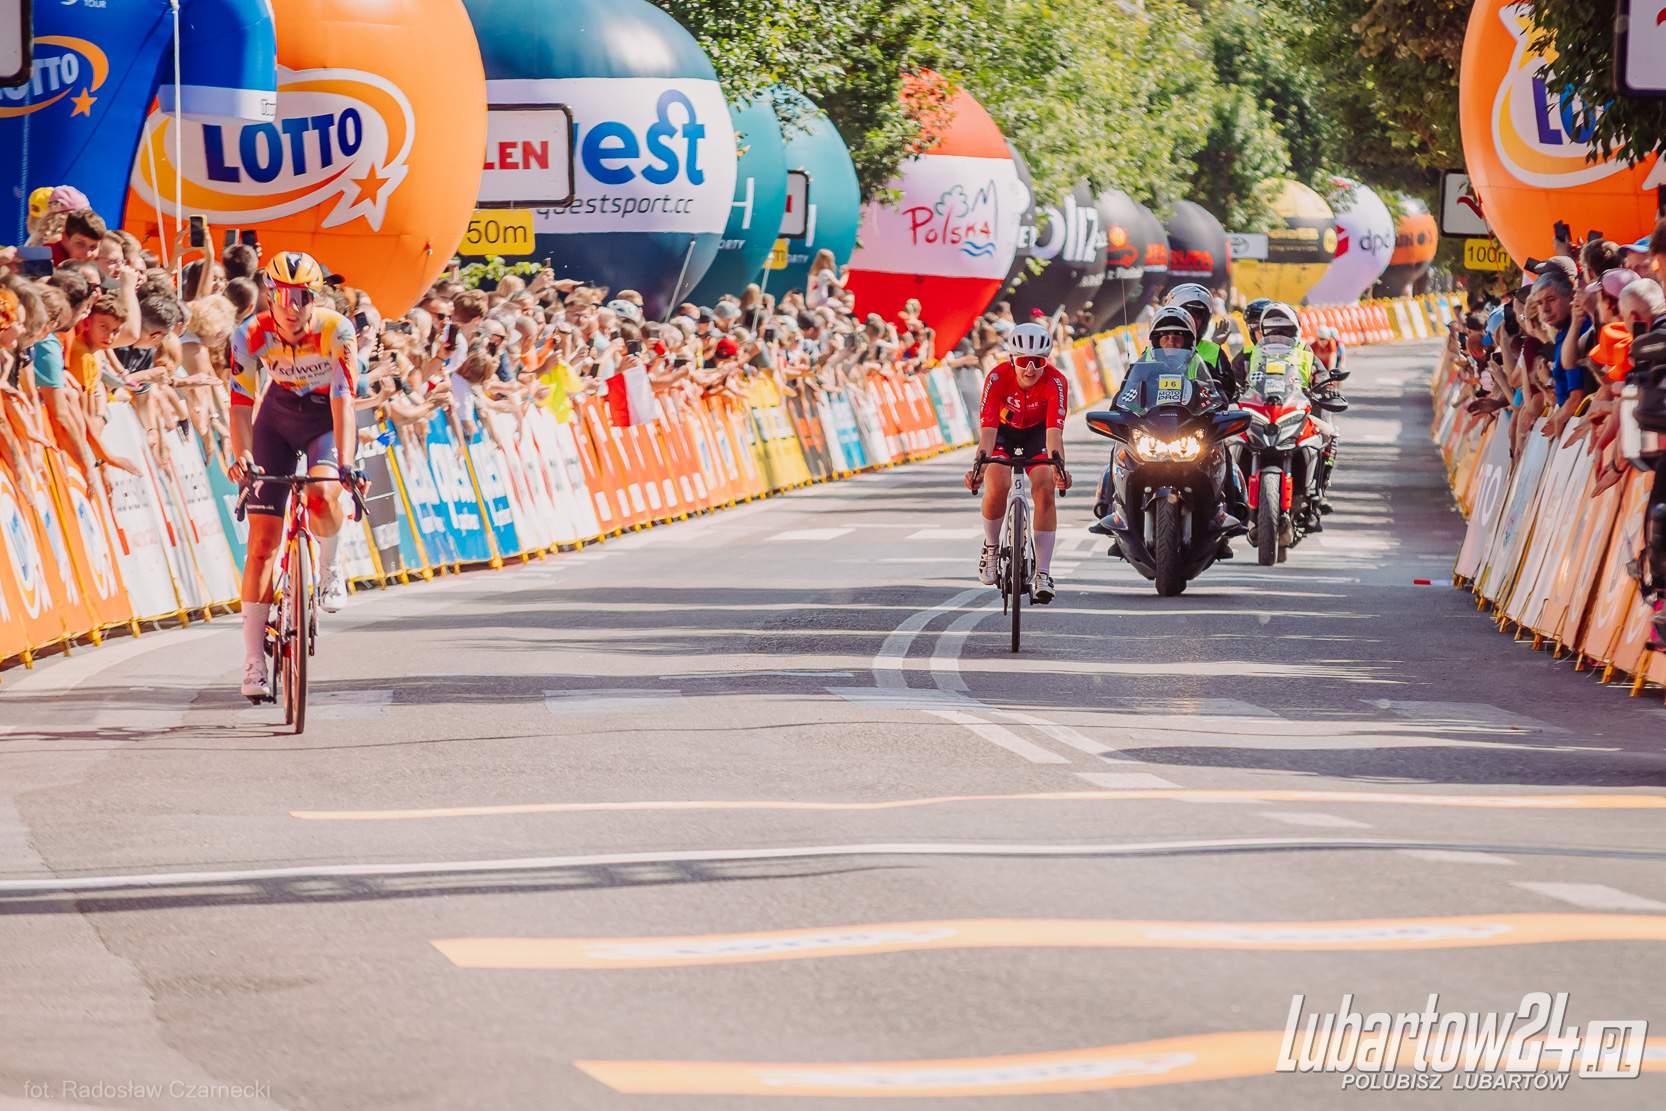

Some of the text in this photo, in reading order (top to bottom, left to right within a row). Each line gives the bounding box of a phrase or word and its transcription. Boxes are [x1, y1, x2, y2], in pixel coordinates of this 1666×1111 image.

[0, 53, 79, 100] TTO
[202, 107, 363, 184] LOTTO
[573, 118, 705, 186] est
[466, 219, 528, 244] 50m
